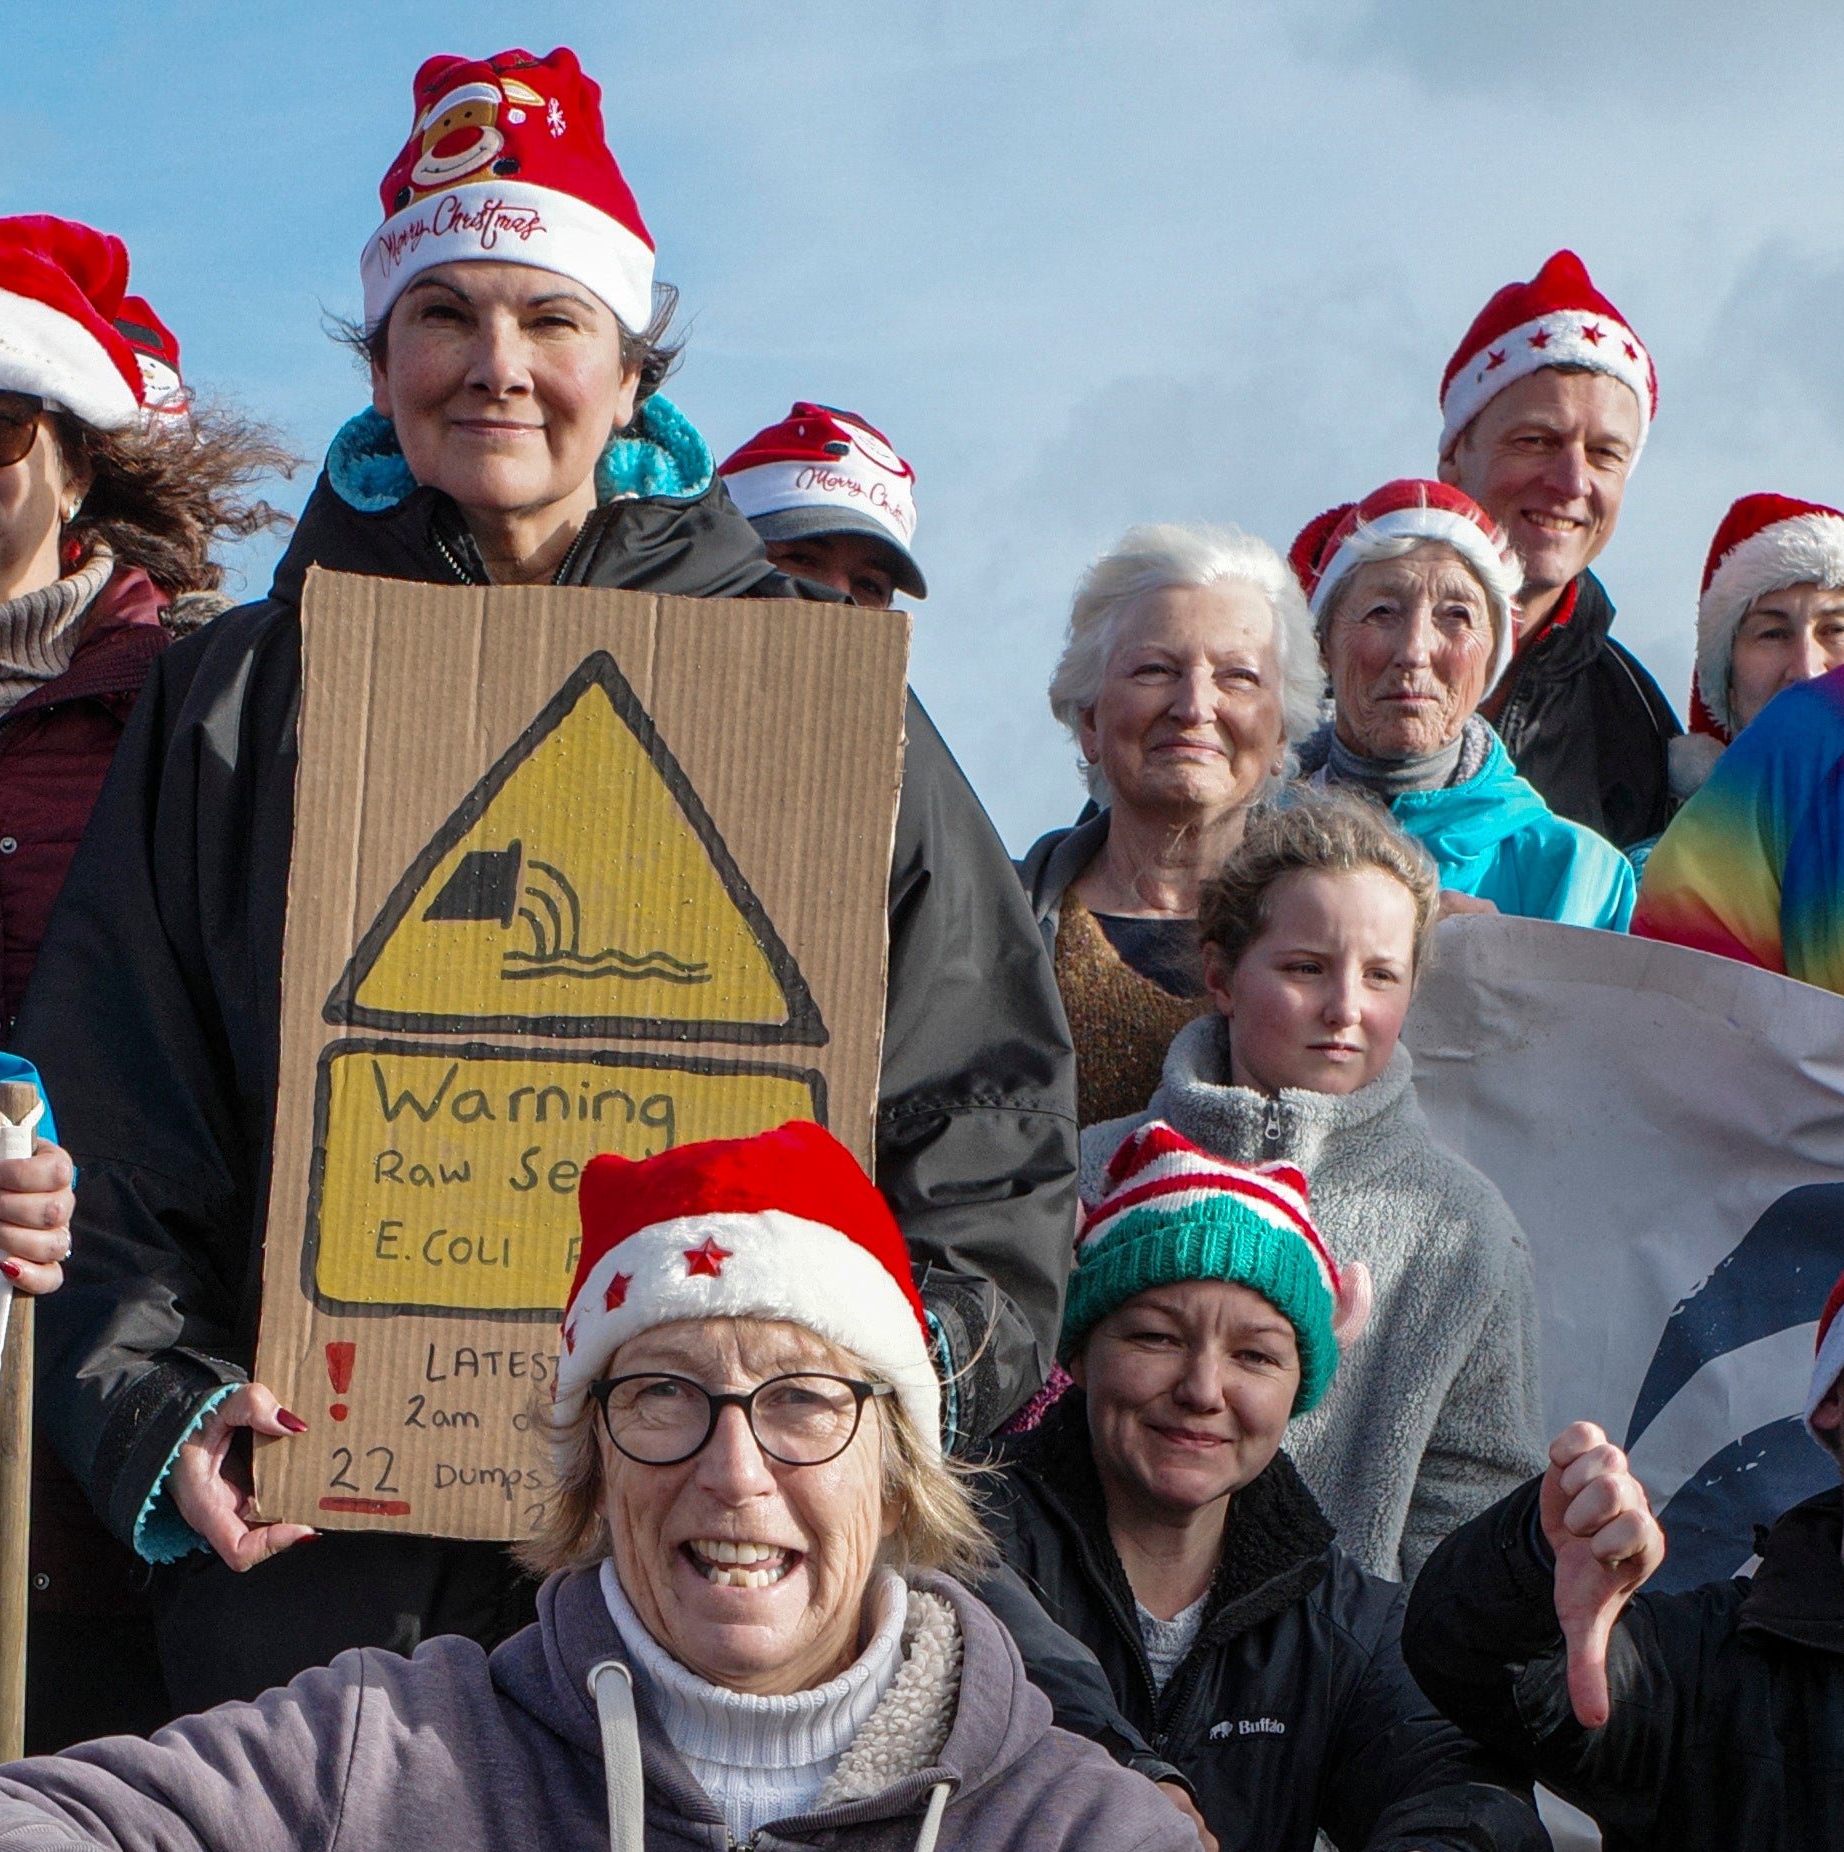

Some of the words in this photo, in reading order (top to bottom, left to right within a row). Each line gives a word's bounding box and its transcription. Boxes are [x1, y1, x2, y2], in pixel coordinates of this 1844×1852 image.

[433, 194, 547, 250] Christmas
[795, 466, 867, 497] Merry
[371, 1059, 676, 1151] Warning
[374, 1149, 472, 1188] Raw
[375, 1220, 510, 1268] E.COLI
[404, 1394, 480, 1430] 2am
[329, 1446, 399, 1493] 22
[1238, 1717, 1286, 1735] Buffalo
